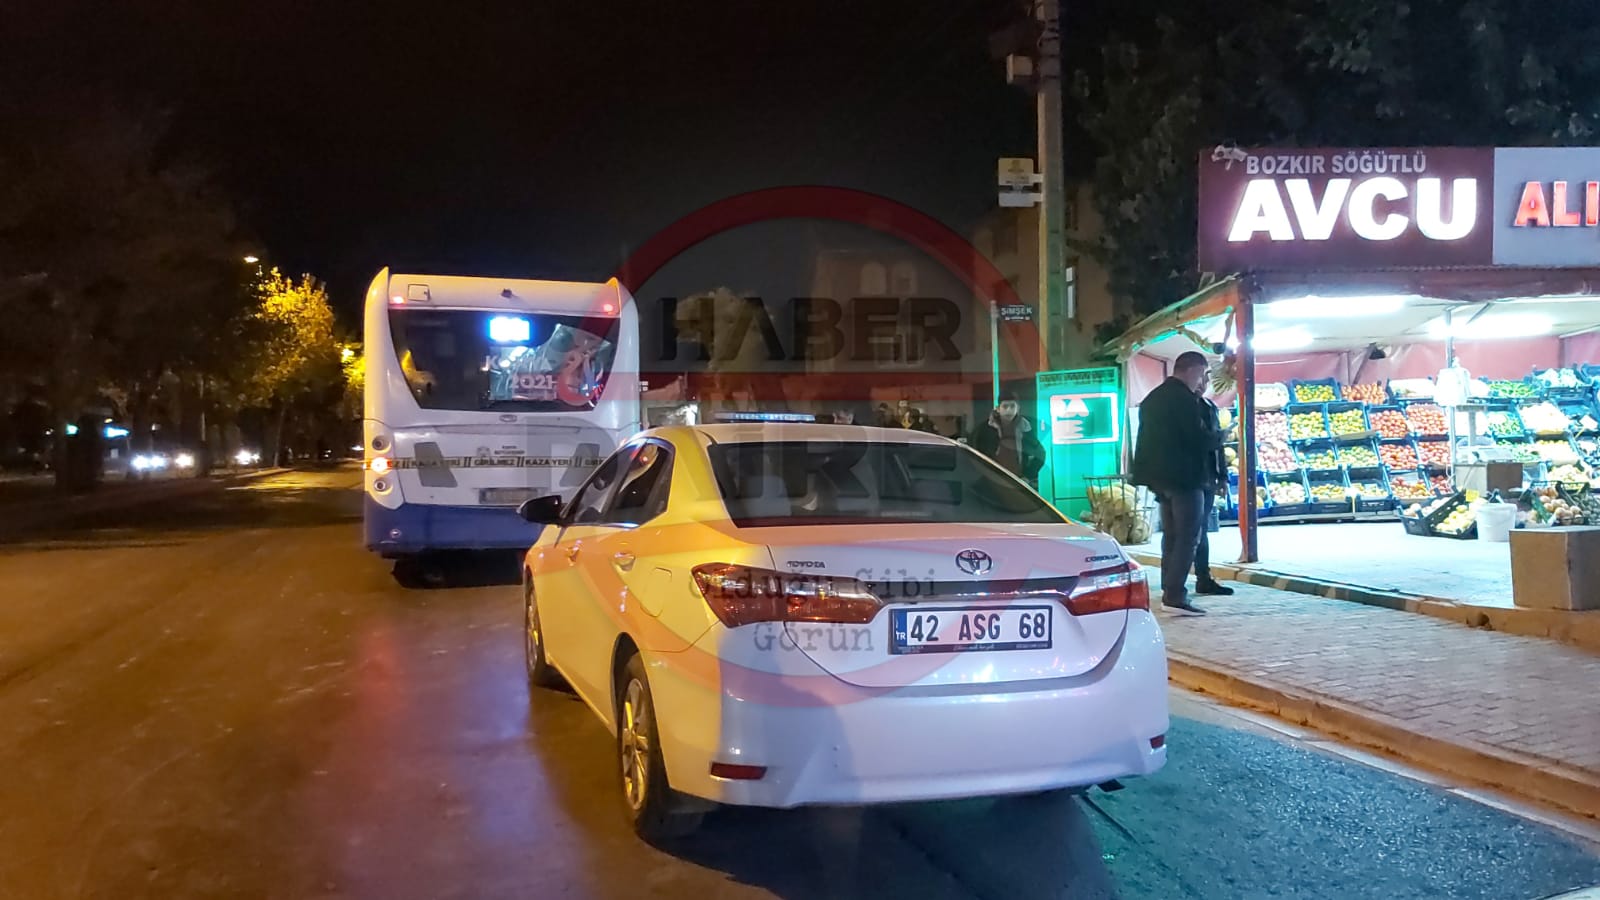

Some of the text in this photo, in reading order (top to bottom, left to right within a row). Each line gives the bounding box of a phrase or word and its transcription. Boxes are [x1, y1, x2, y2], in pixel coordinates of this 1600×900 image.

[1247, 150, 1426, 175] BOZKIR SÖĞÜTLÜ
[1227, 176, 1477, 242] AVCU
[787, 560, 826, 569] TOYOTA
[895, 630, 907, 641] TR
[910, 612, 1046, 642] 42 ASG 68
